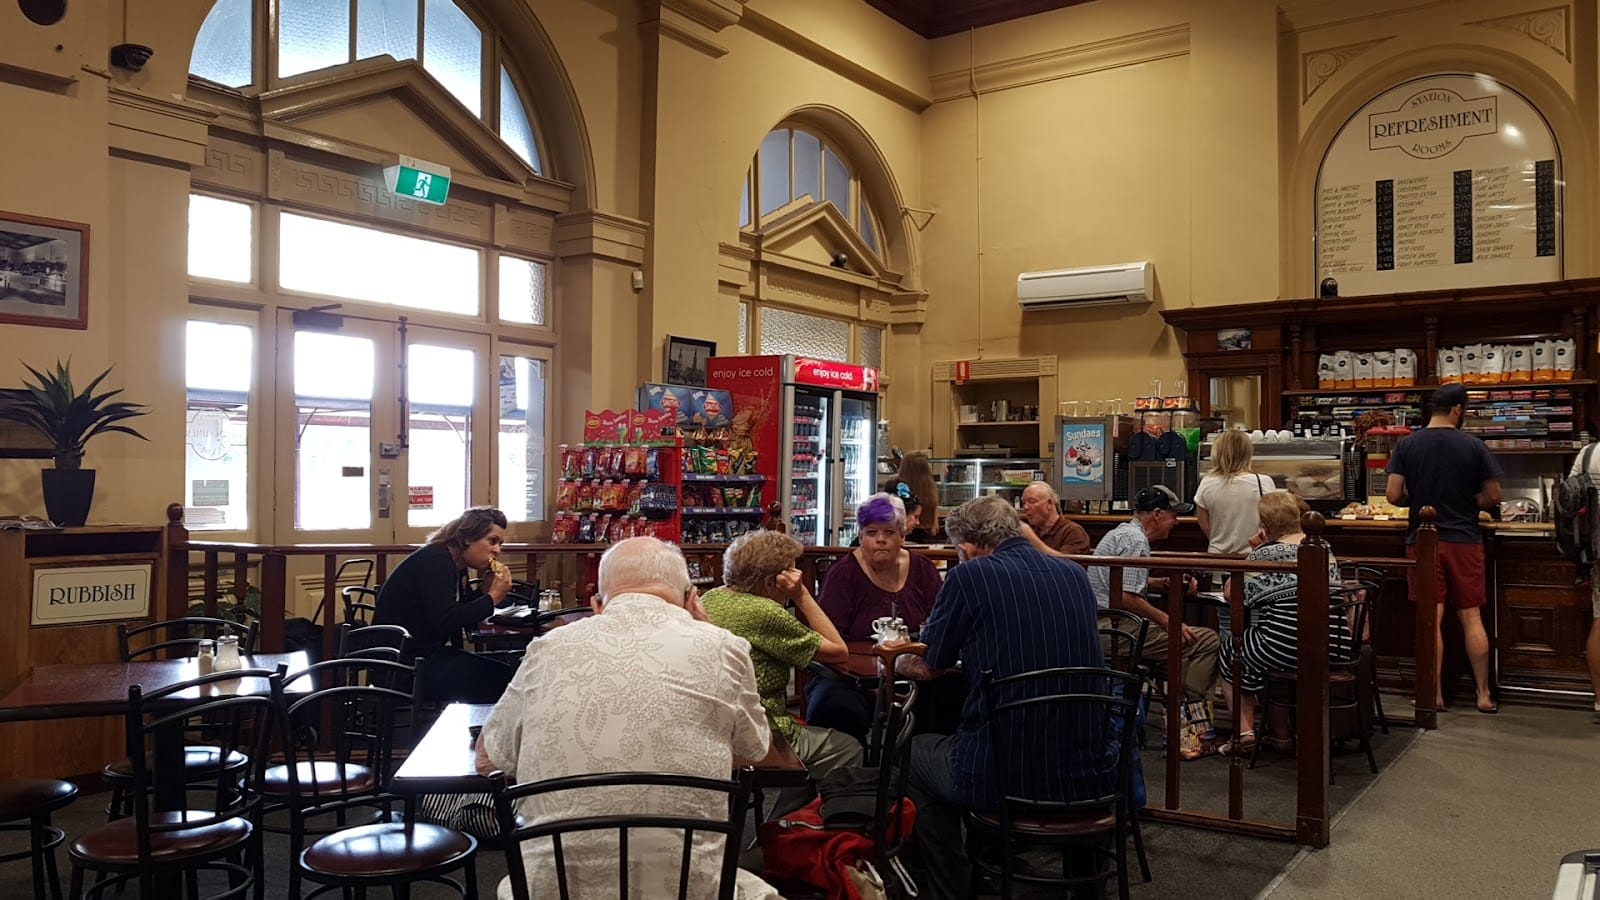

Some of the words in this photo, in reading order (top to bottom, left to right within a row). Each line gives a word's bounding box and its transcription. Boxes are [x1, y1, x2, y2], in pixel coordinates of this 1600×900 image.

[1411, 91, 1452, 108] STATION
[1374, 108, 1493, 139] REFRESHMENT
[1412, 140, 1453, 154] ROOMS
[712, 369, 736, 380] enjoy
[738, 368, 751, 378] ice
[753, 367, 774, 377] cold
[813, 367, 829, 379] enjoy
[830, 368, 839, 379] ice
[840, 370, 853, 381] cold
[1066, 428, 1101, 441] Sundaes
[49, 583, 136, 605] RUBBISH
